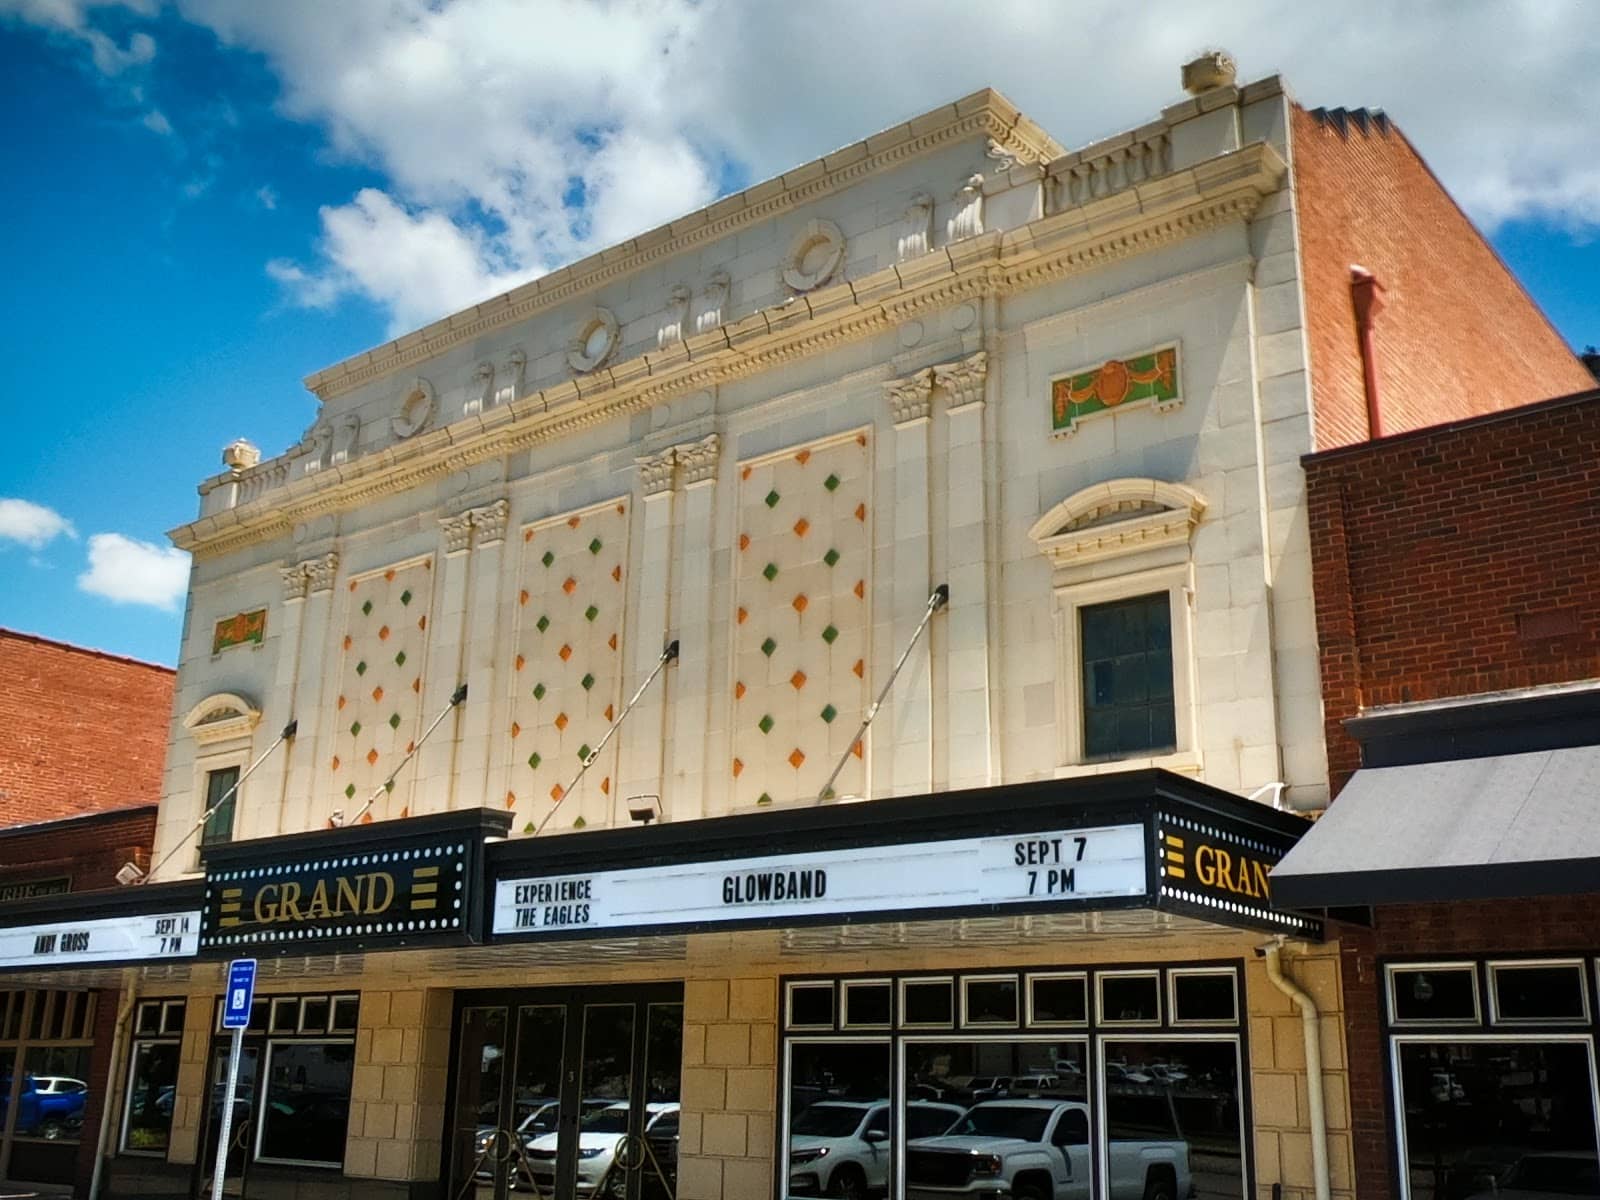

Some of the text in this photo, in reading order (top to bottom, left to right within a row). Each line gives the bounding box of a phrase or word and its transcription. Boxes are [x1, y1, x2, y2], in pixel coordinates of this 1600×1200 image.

[1015, 837, 1088, 866] SEPT 7
[1027, 868, 1075, 895] 7 PM
[1195, 845, 1273, 898] GRAN
[253, 871, 395, 924] GRAND
[515, 879, 592, 905] EXPERIENCE
[722, 869, 827, 904] GLOWBAND
[155, 917, 190, 935] SEPT 14
[515, 904, 590, 927] THE EAGLES
[33, 932, 90, 954] ANDY GROSS
[160, 937, 183, 953] 7 PM
